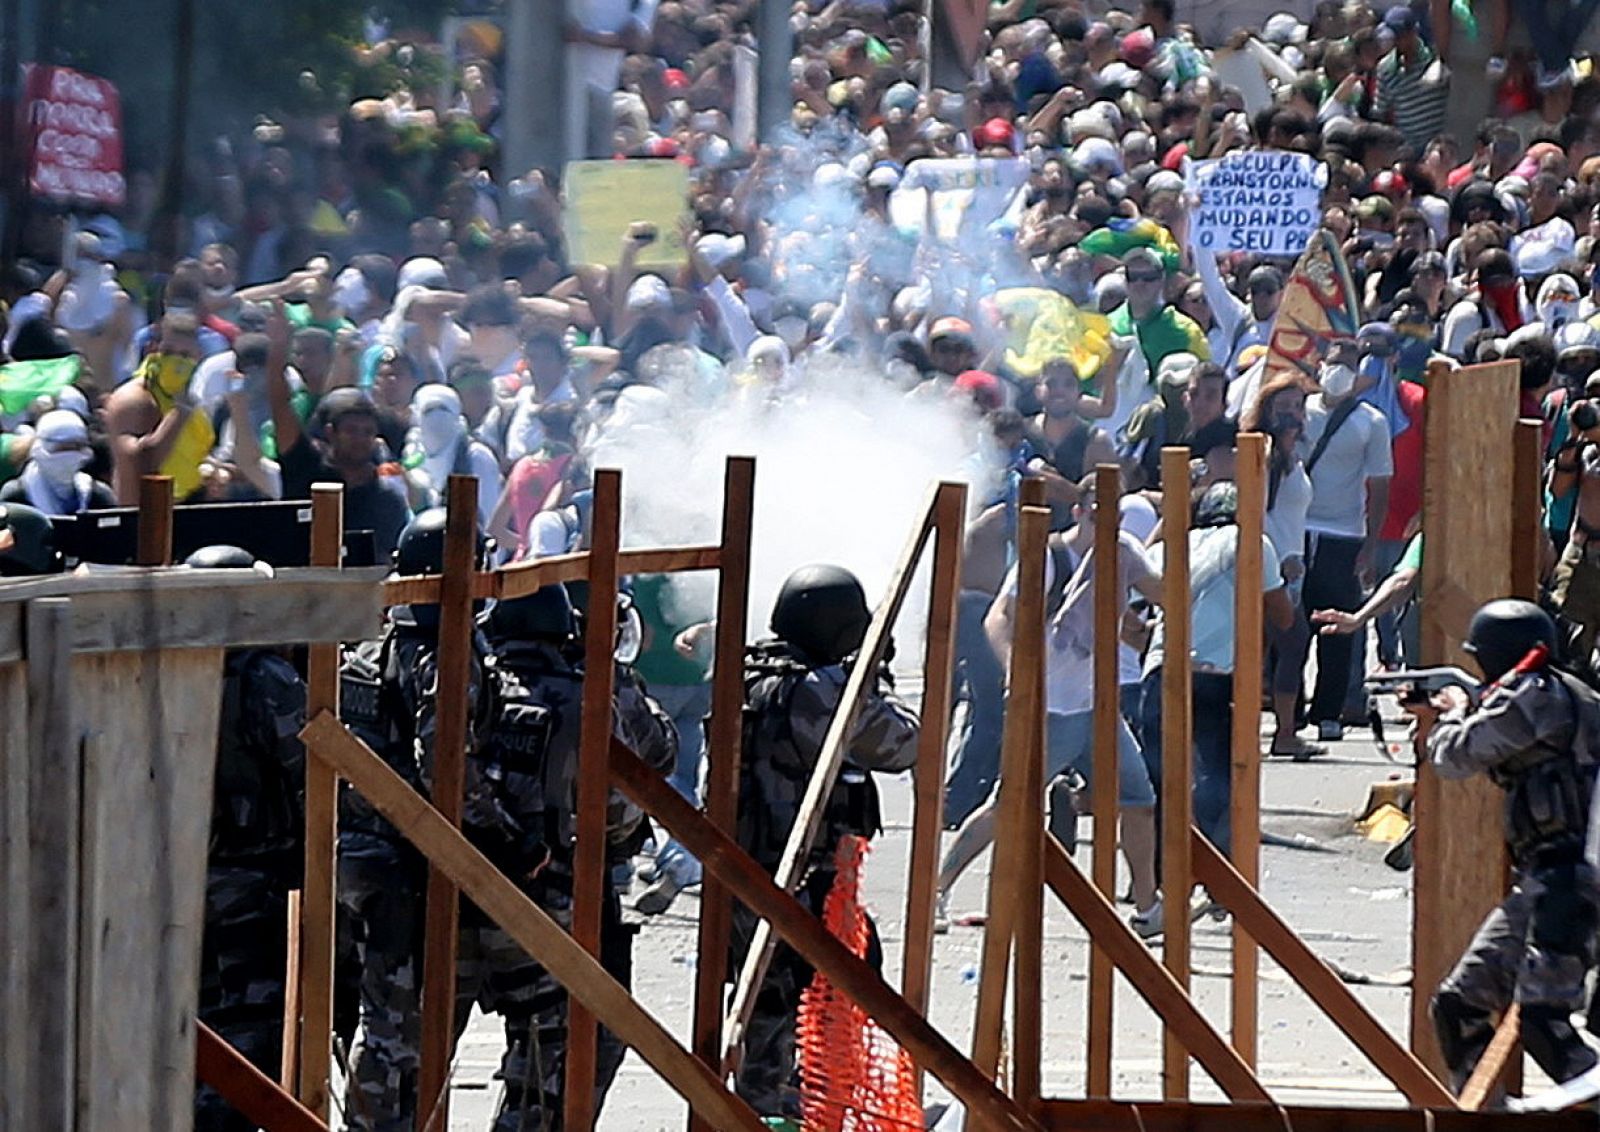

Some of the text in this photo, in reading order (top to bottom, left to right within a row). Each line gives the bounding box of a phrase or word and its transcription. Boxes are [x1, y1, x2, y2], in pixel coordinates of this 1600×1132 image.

[1211, 153, 1302, 172] ESCULPE
[1199, 189, 1295, 207] ESTAMOS
[1198, 209, 1311, 227] MUDANDO
[1199, 228, 1308, 249] O SEU PA
